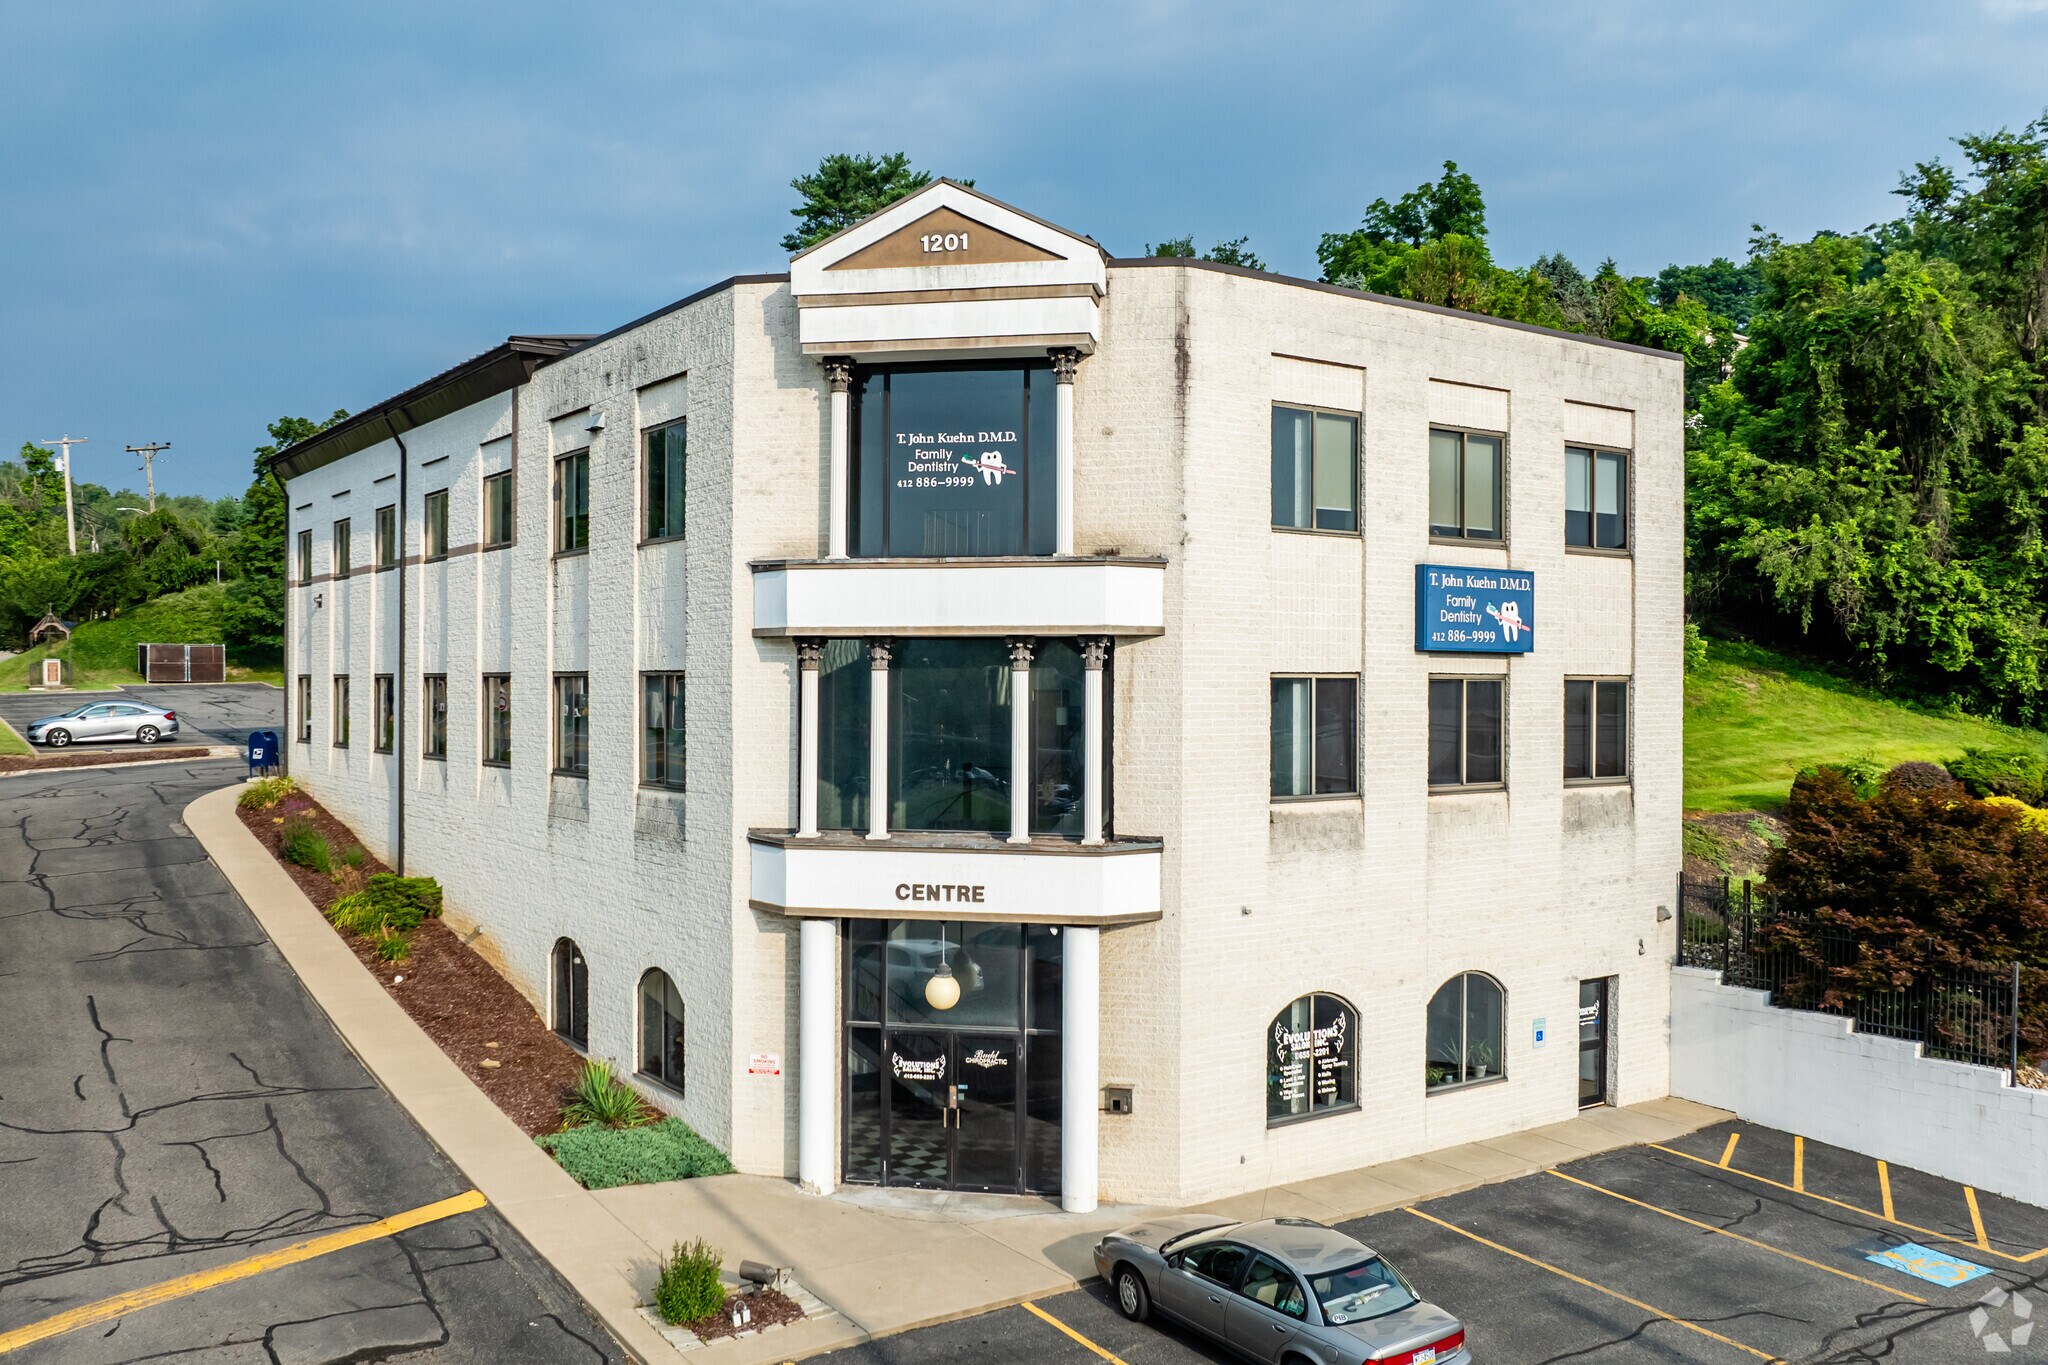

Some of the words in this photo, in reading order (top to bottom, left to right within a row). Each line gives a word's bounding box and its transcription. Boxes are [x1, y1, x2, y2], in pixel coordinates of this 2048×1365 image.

[920, 233, 968, 252] 1201
[896, 433, 906, 444] T.
[908, 433, 934, 446] John
[937, 433, 975, 444] Kuehn
[978, 431, 1017, 443] D.M.D.
[915, 449, 953, 461] Family
[908, 462, 959, 474] Dentistry
[896, 479, 913, 488] 412
[915, 476, 974, 488] 886-9999
[1429, 573, 1438, 586] T.
[1441, 573, 1463, 589] John
[1466, 575, 1497, 589] Kuehn
[1500, 577, 1531, 591] D.M.D.
[1446, 594, 1476, 609] Family
[1440, 609, 1482, 626] Dentistry
[1432, 632, 1446, 642] 412
[1447, 629, 1496, 643] 886-9999
[895, 883, 985, 902] CENTRE
